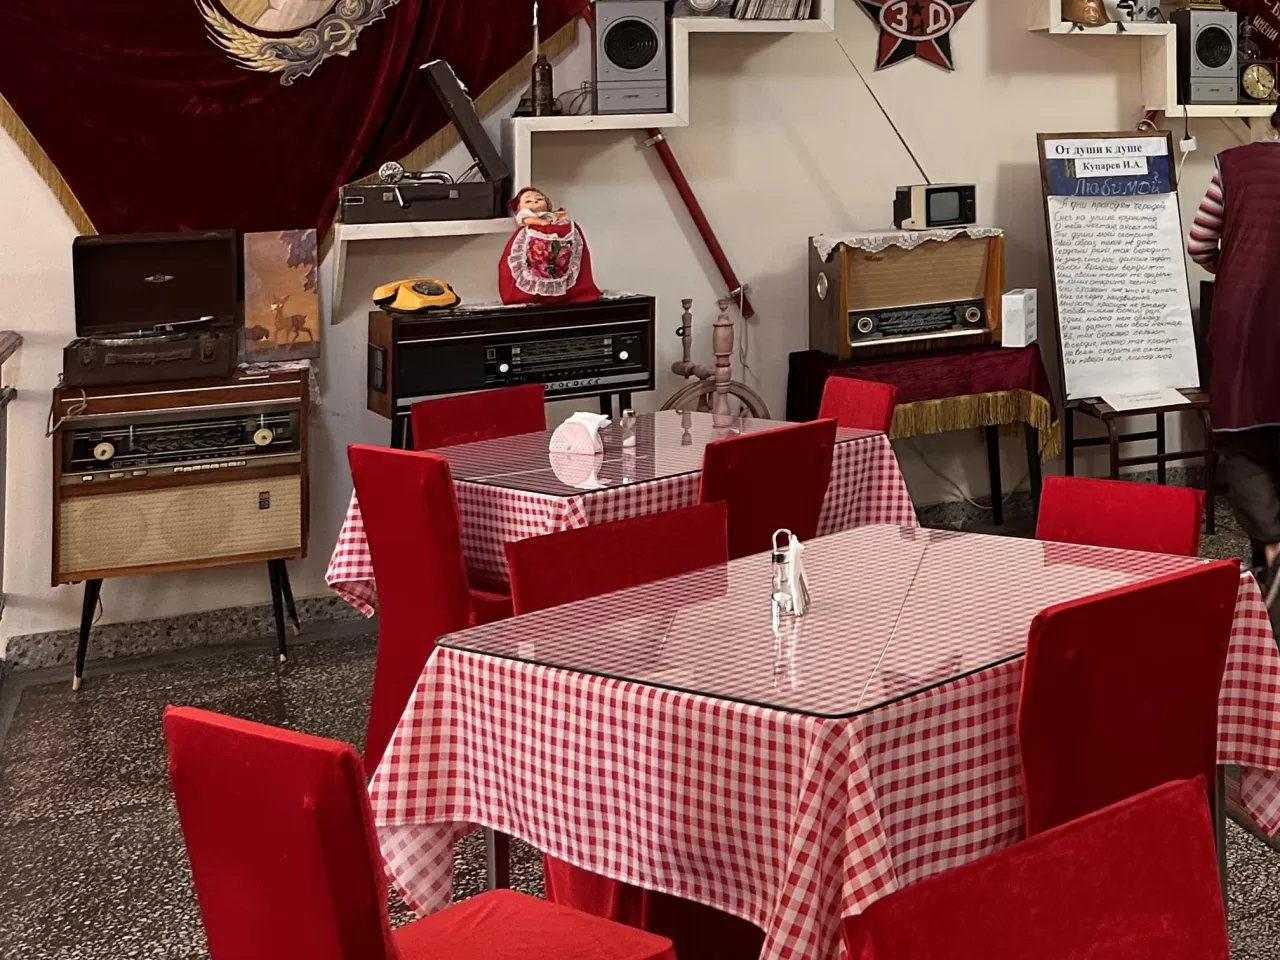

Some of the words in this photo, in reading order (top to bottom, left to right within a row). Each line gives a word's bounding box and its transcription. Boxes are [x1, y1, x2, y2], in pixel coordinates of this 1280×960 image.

[1055, 145, 1070, 155] От
[1073, 146, 1103, 157] души
[1105, 146, 1113, 154] к
[1115, 145, 1142, 156] душе
[1123, 161, 1143, 170] И.А.
[1073, 172, 1162, 196] Любимой
